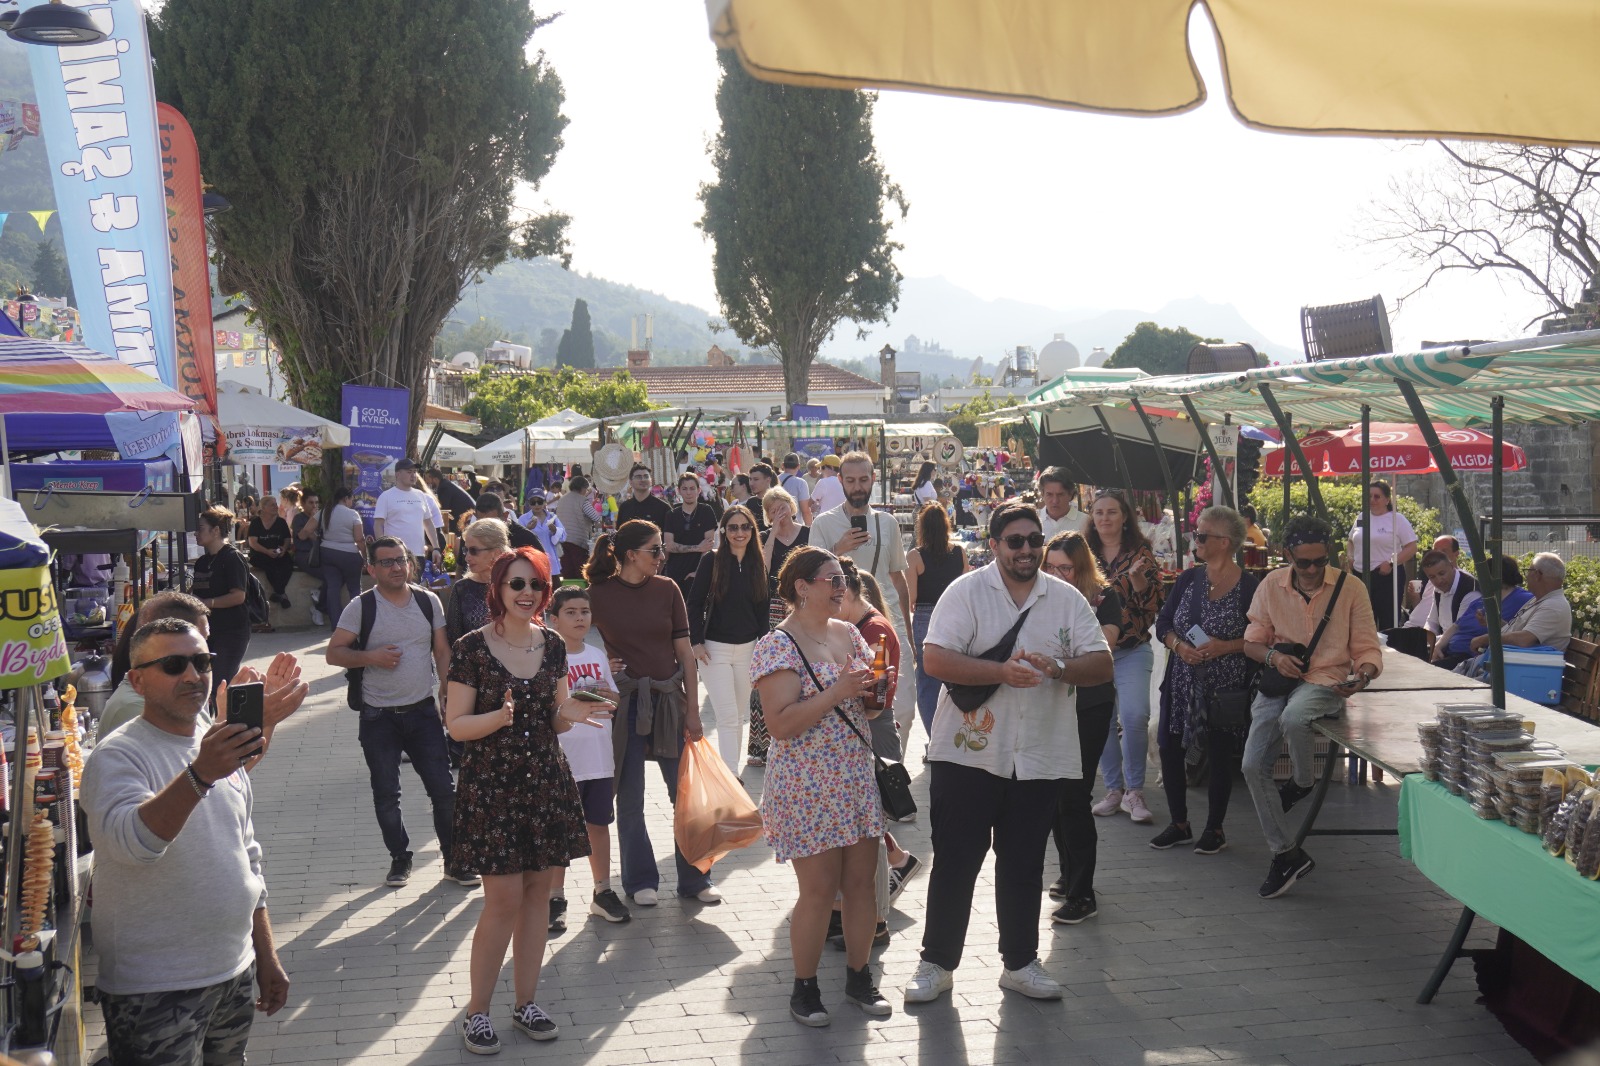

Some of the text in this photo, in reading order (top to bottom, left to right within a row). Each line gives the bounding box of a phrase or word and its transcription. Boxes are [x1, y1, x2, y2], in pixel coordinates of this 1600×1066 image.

[361, 415, 401, 426] KYRENIA
[235, 438, 272, 449] & Şamişi
[1348, 455, 1407, 470] AGiDA
